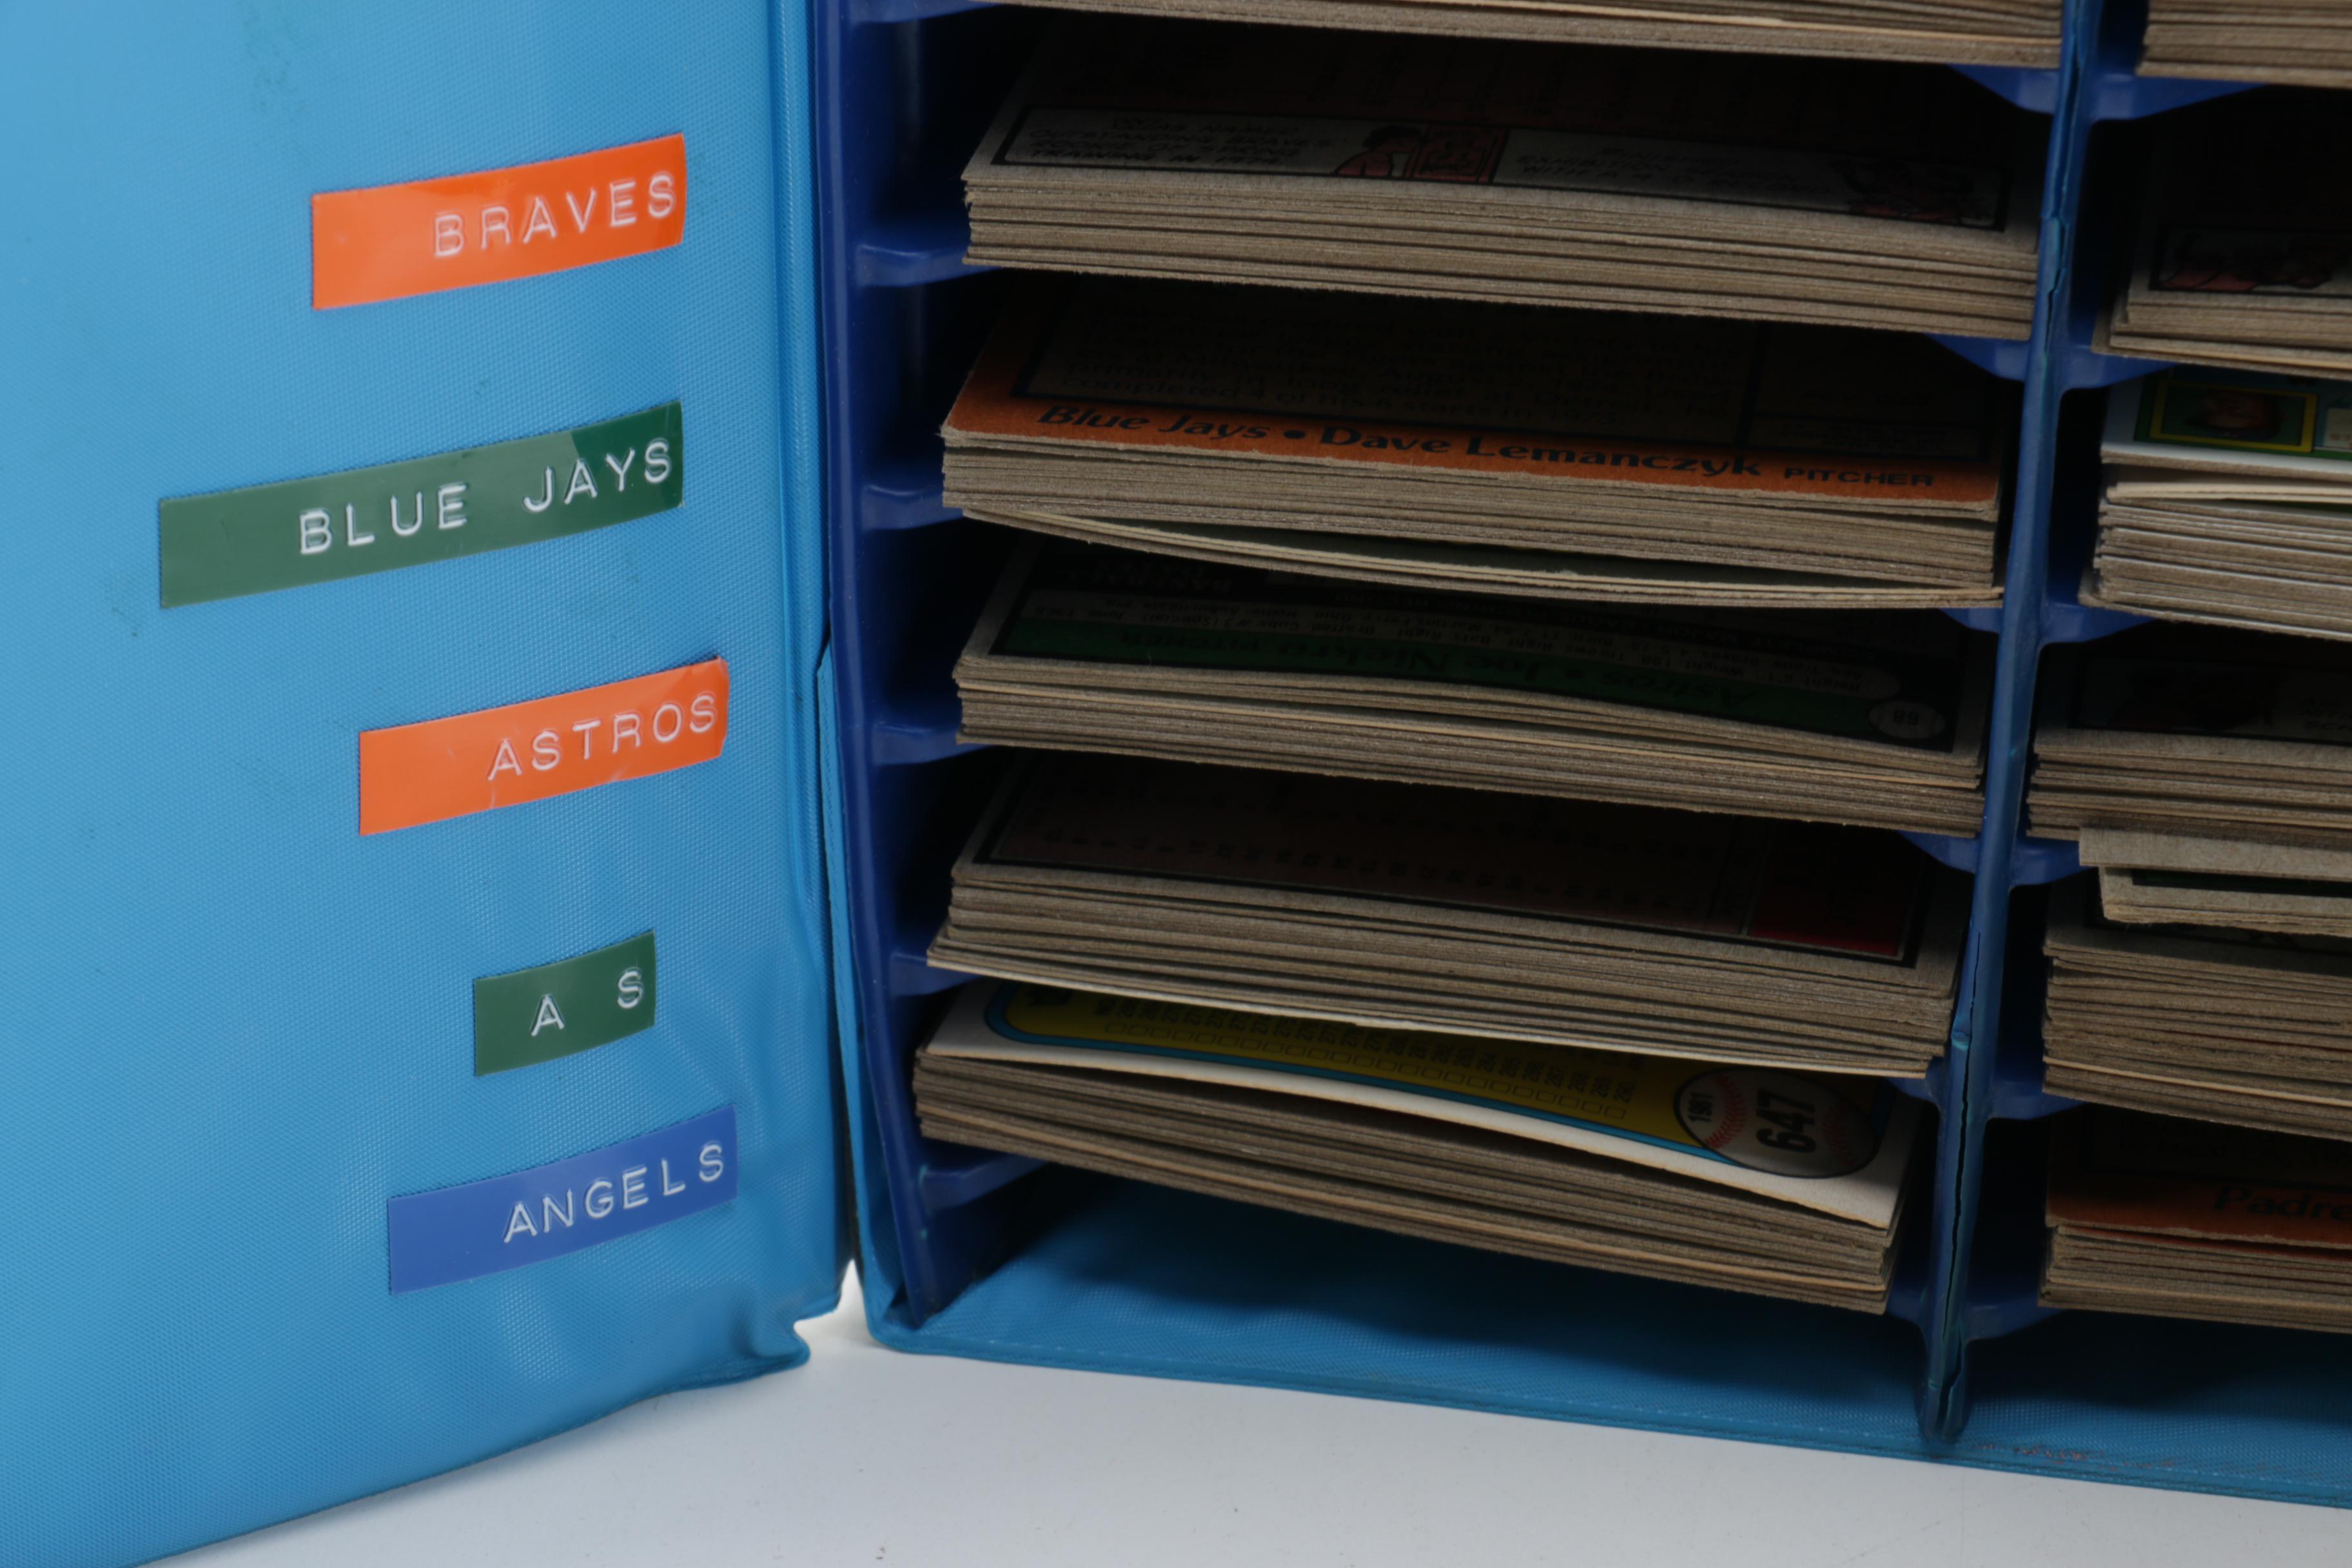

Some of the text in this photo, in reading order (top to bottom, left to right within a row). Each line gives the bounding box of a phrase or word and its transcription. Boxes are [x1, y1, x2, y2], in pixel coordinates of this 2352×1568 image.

[433, 172, 676, 258] BRAVES
[1037, 406, 1150, 430] Blue
[1160, 415, 1270, 440] Jays
[1320, 426, 1451, 456] Dave
[1465, 436, 1762, 478] Lemanczyk
[1784, 466, 1934, 487] PITCHER
[299, 440, 672, 555] BLUE JAYS
[1279, 642, 1449, 672] Niekro
[1466, 656, 1540, 682] Joe
[1600, 671, 1758, 709] Astros
[487, 694, 718, 781] ASTROS
[1893, 709, 1919, 727] 68
[531, 968, 644, 1037] A S
[1687, 1092, 1712, 1122] 1981
[1756, 1088, 1816, 1153] 647
[504, 1144, 724, 1244] ANGELS
